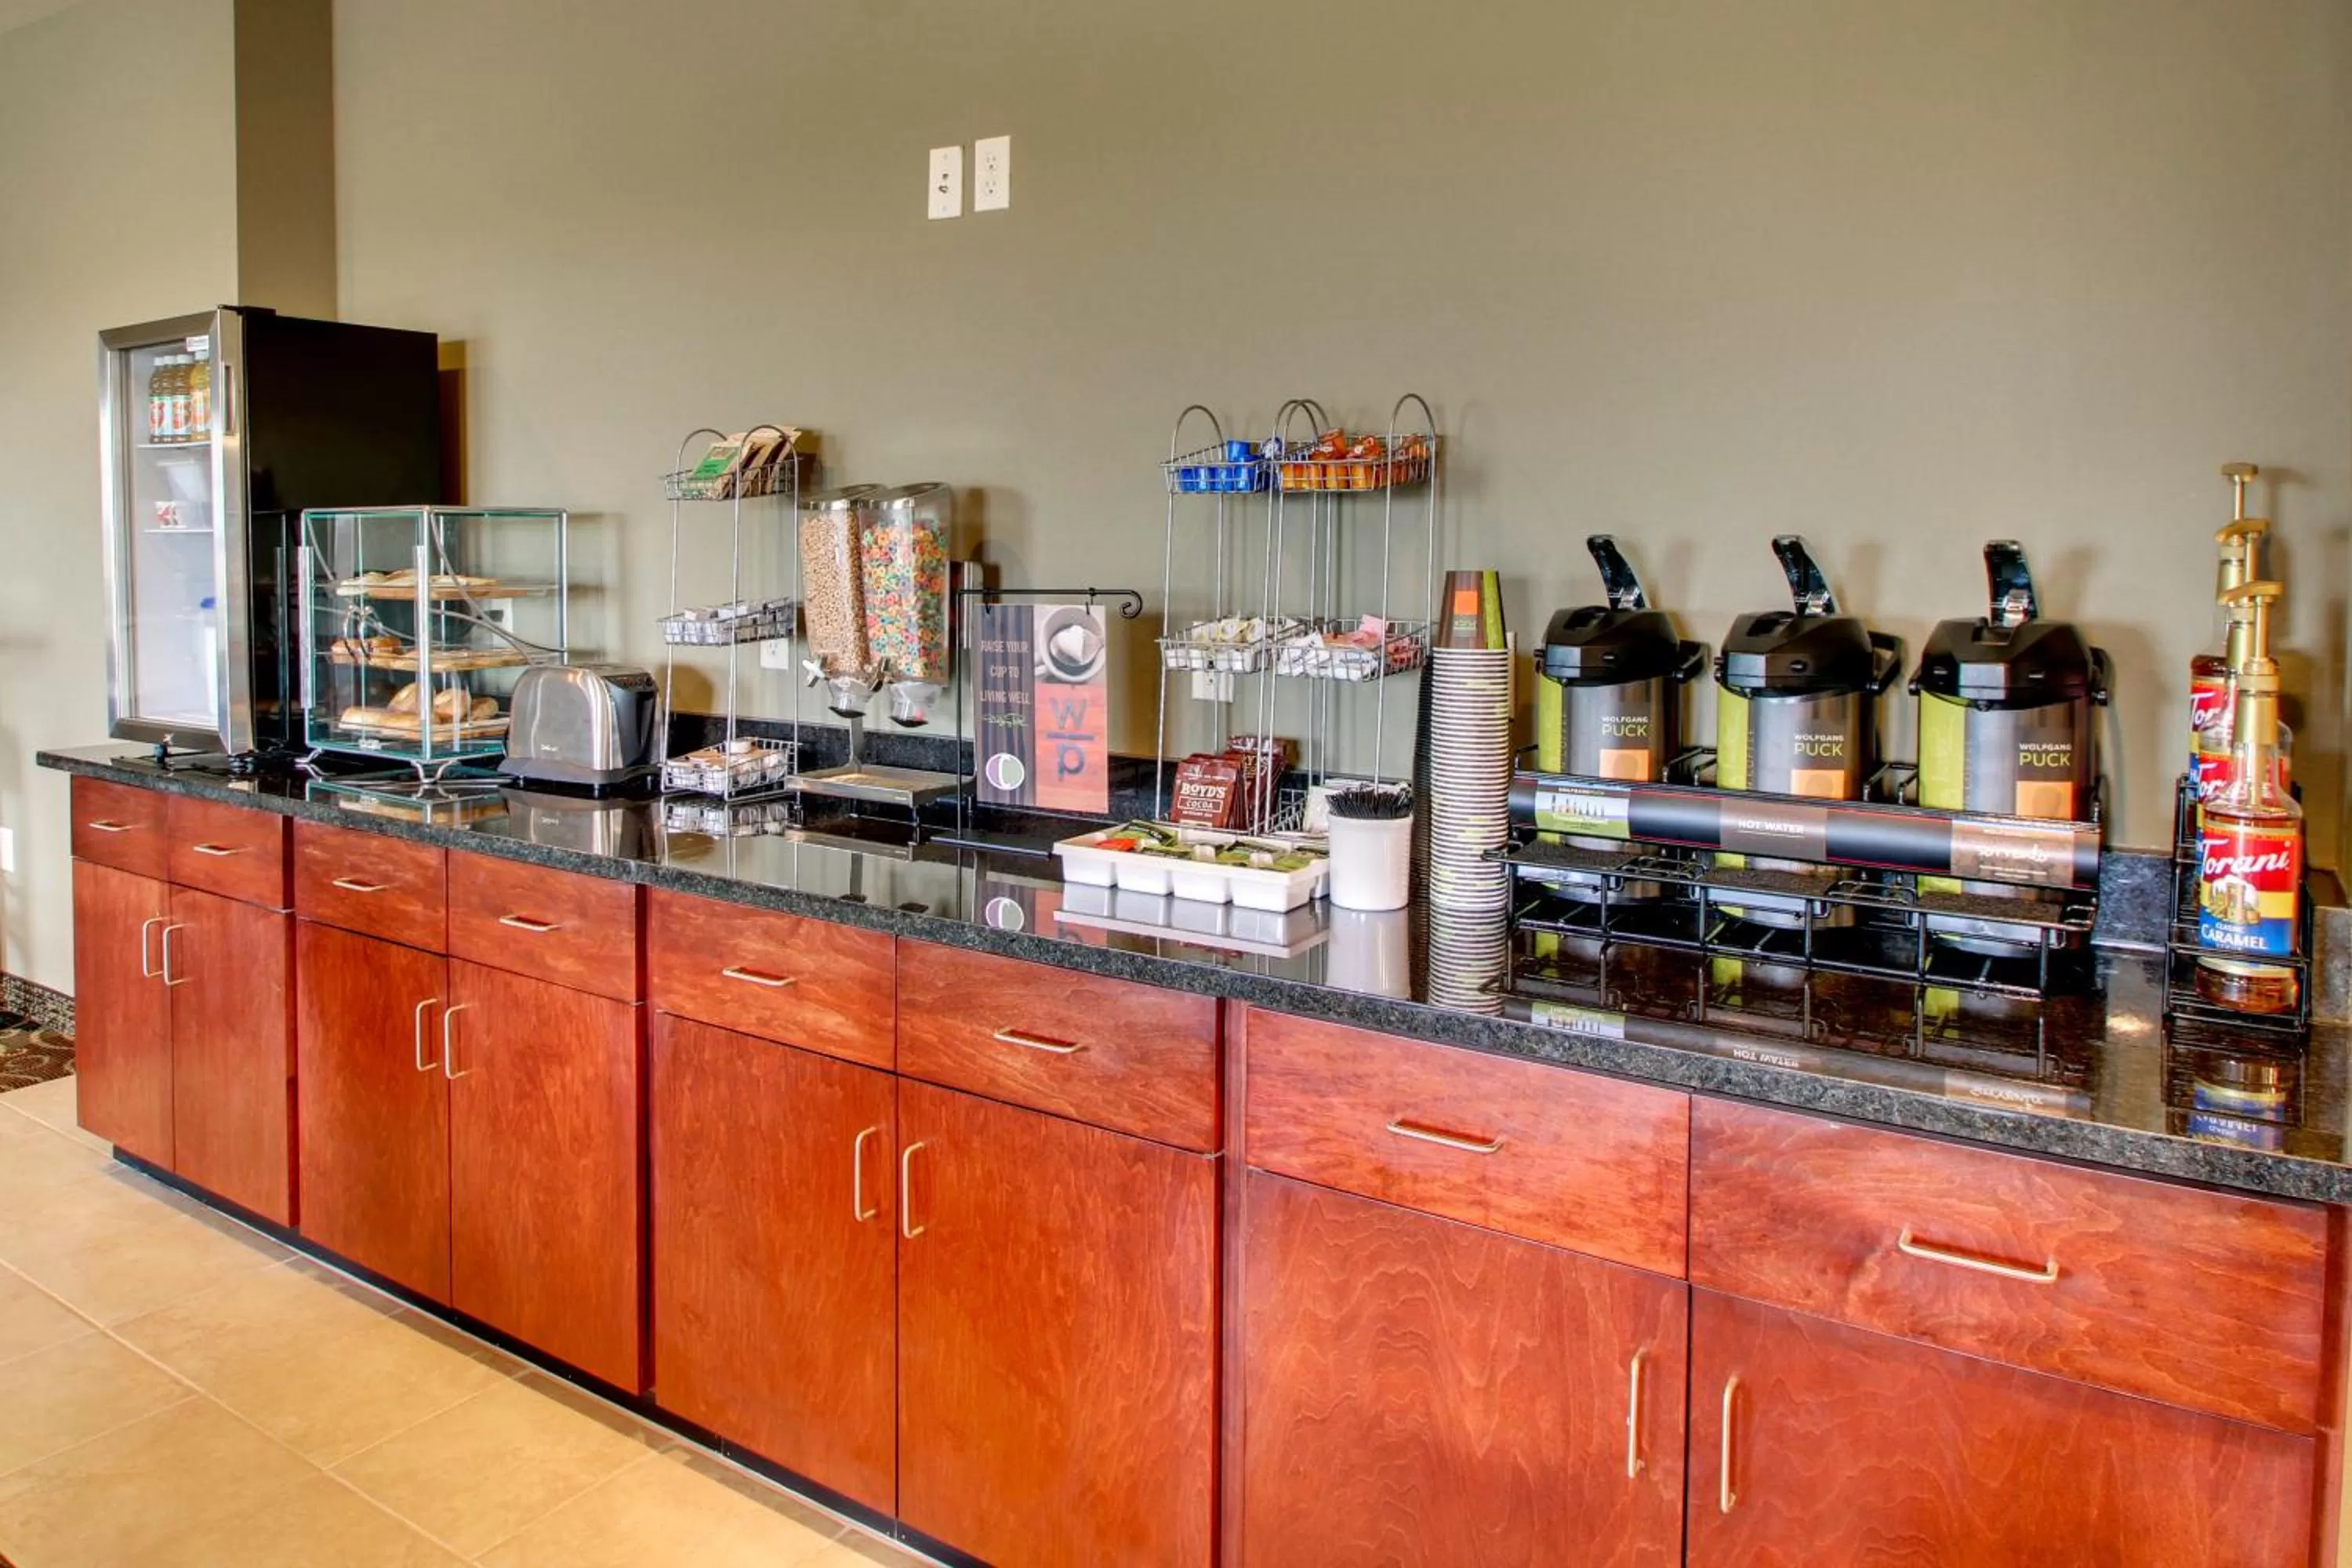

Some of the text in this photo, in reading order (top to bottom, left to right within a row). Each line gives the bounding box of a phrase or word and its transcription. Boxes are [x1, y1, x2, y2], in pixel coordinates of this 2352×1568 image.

[1007, 640, 1029, 653] YOUR
[990, 666, 1019, 678] CUP TO
[979, 690, 1031, 705] LIVING WELL
[1602, 724, 1648, 737] PUCK
[1794, 733, 1845, 742] WOLFGANG
[1794, 742, 1843, 757] PUCK
[2019, 742, 2072, 751] WOLFGANG
[2019, 752, 2071, 767] PUCK
[1180, 782, 1229, 799] BOYD'S
[1737, 818, 1805, 835] HOT WATER
[2201, 837, 2292, 879] Torani
[2201, 923, 2269, 950] CARAMEL
